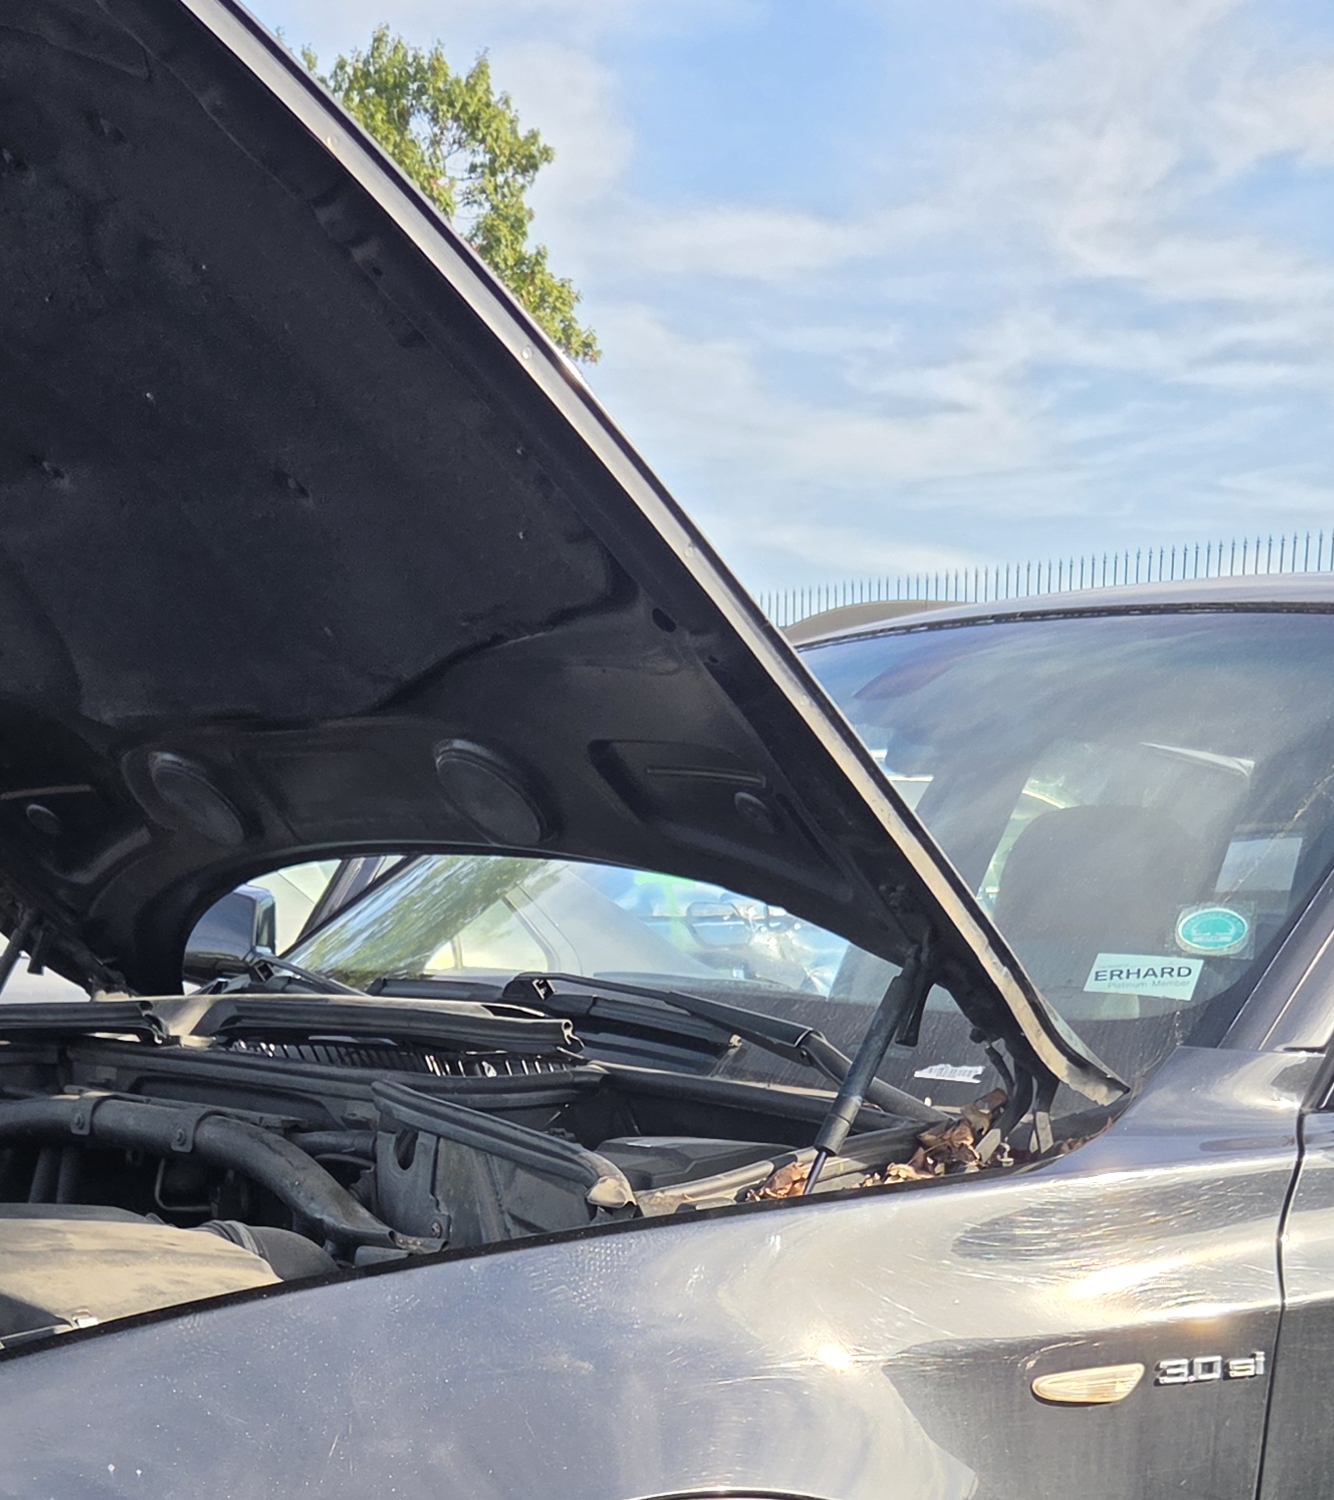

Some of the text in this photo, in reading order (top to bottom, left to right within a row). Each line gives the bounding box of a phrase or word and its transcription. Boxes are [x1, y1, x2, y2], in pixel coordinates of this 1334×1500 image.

[1094, 966, 1192, 981] ERHARD
[1107, 979, 1191, 989] Platinum Member
